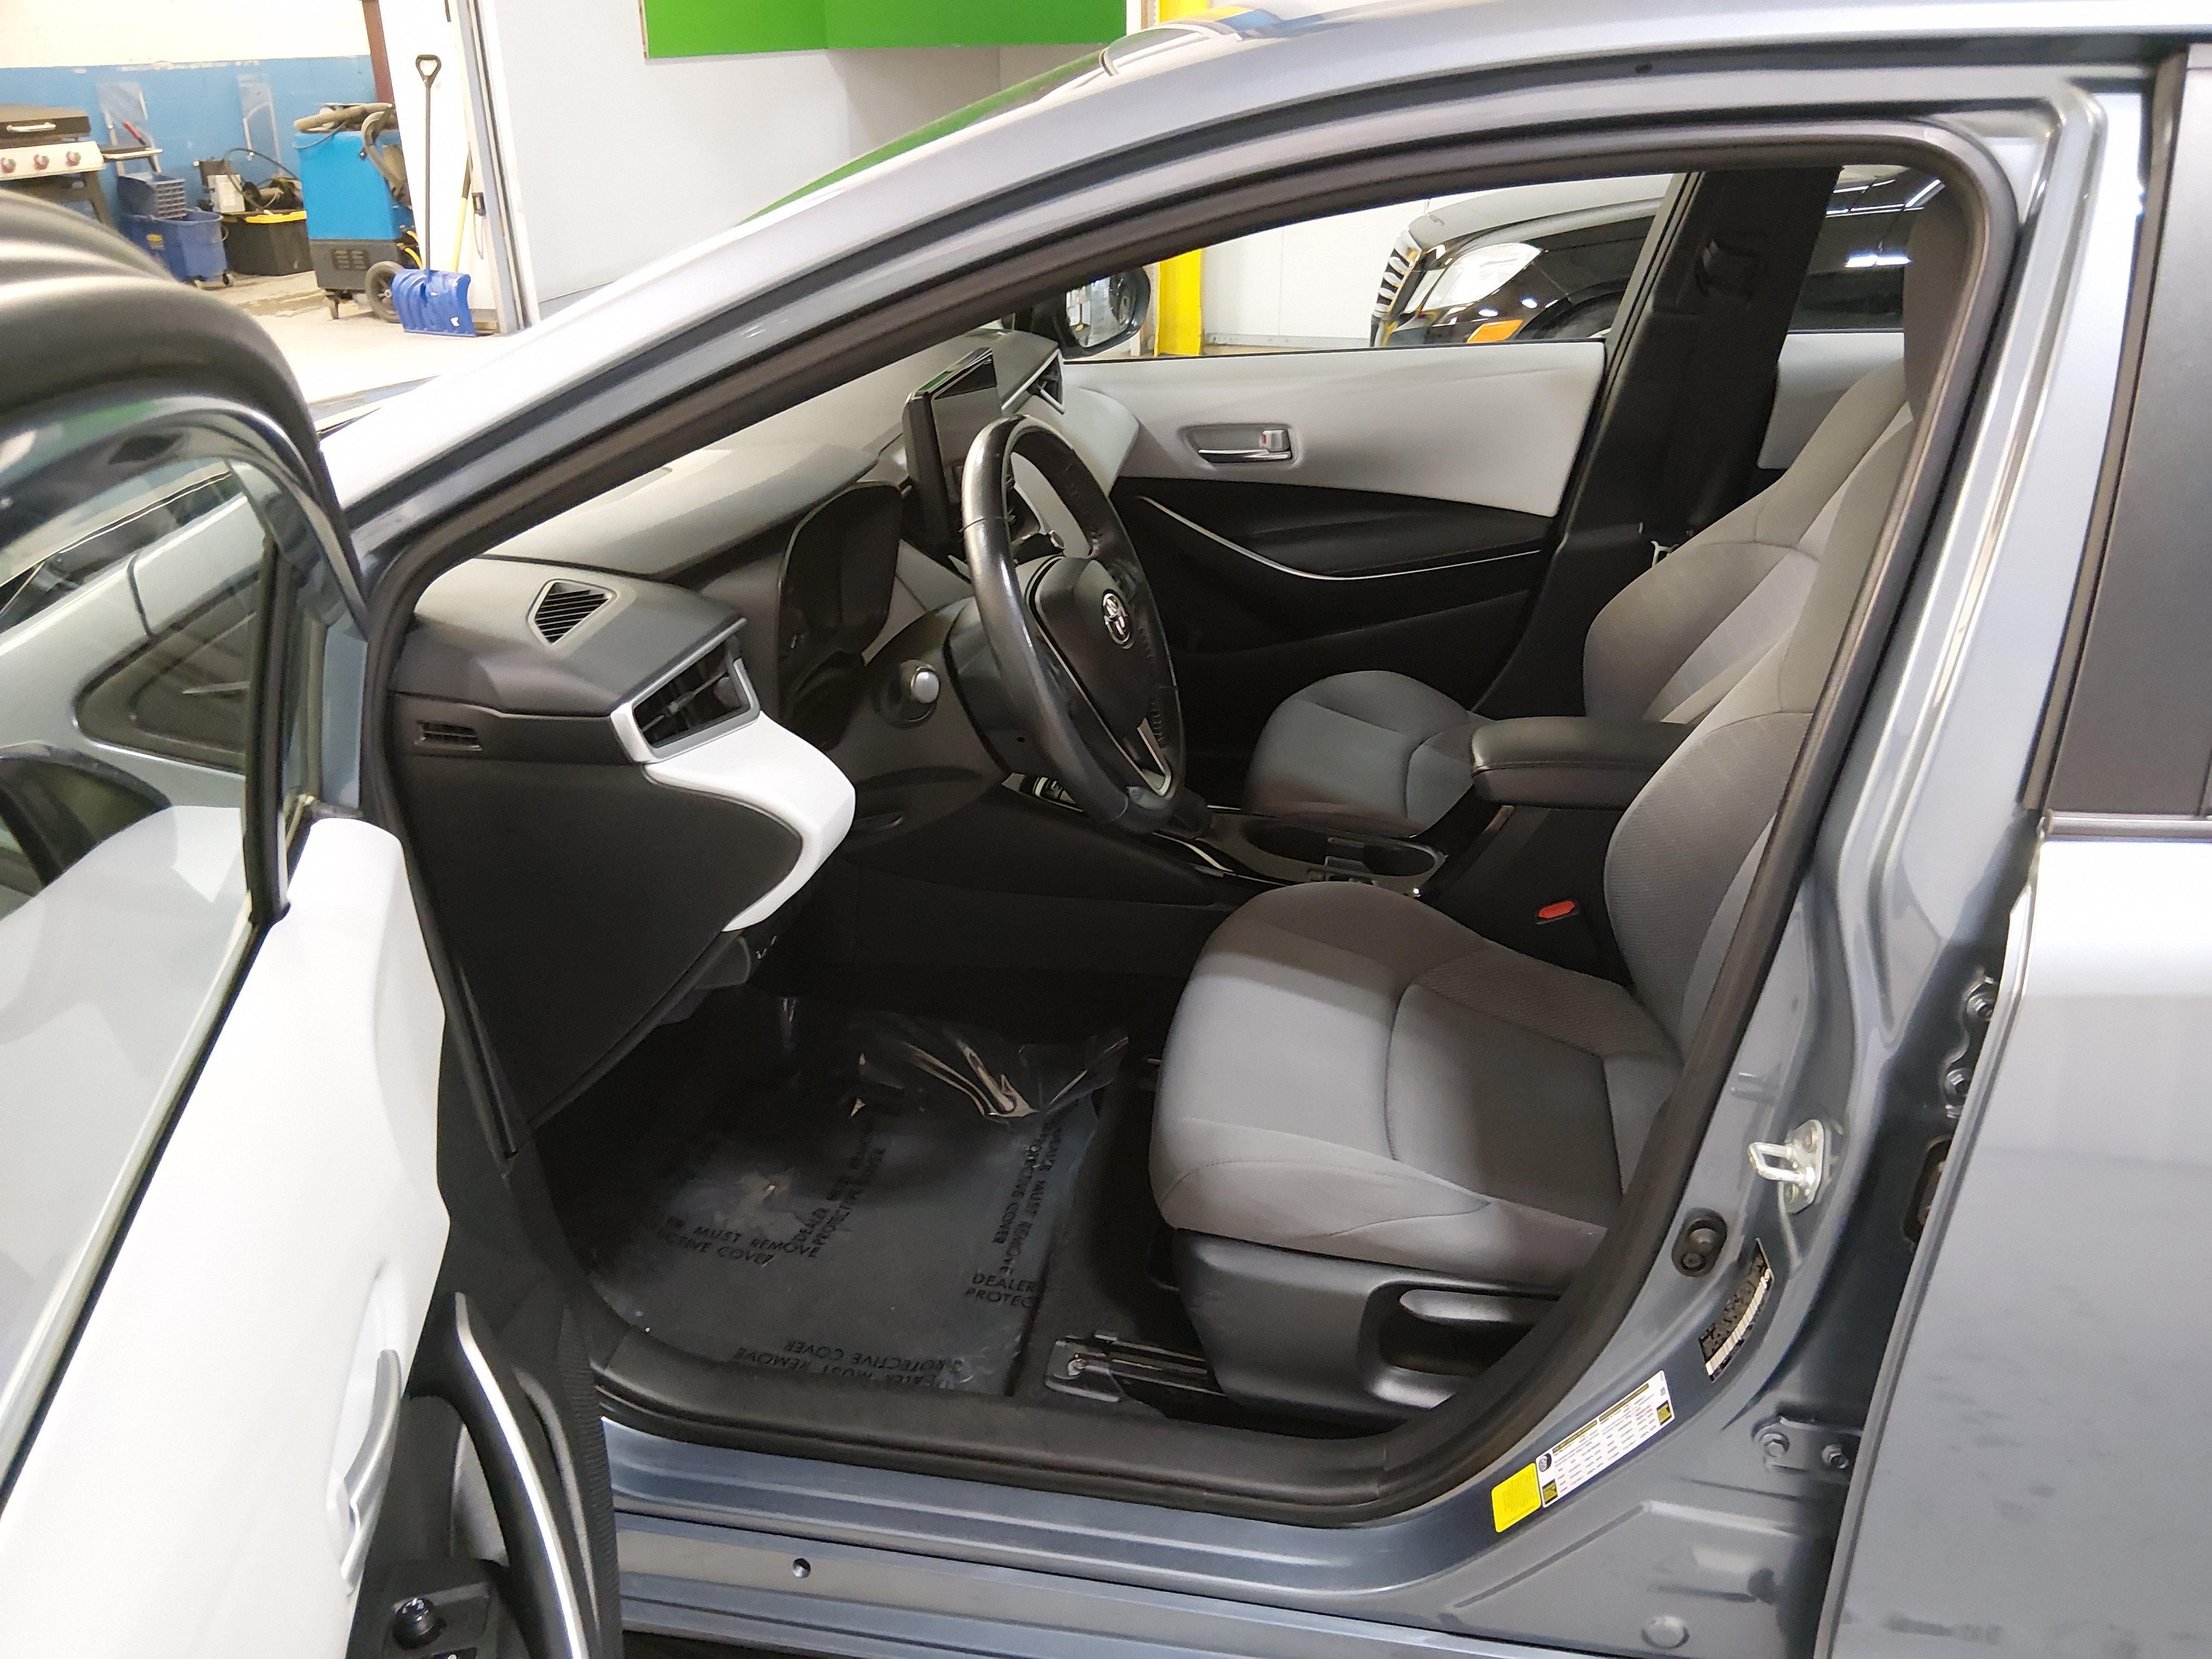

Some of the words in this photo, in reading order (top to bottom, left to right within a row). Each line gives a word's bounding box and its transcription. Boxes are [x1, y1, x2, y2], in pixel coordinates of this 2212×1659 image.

[1026, 1180, 1046, 1218] MUST
[992, 1202, 1020, 1244] COVER
[693, 1226, 742, 1243] MUST
[749, 1238, 822, 1258] REMOVE
[717, 1246, 774, 1265] COVER
[972, 1272, 1037, 1293] DEALER
[964, 1288, 1036, 1308] PROTEC
[734, 1346, 812, 1372] REMOVE
[785, 1340, 844, 1361] COVER
